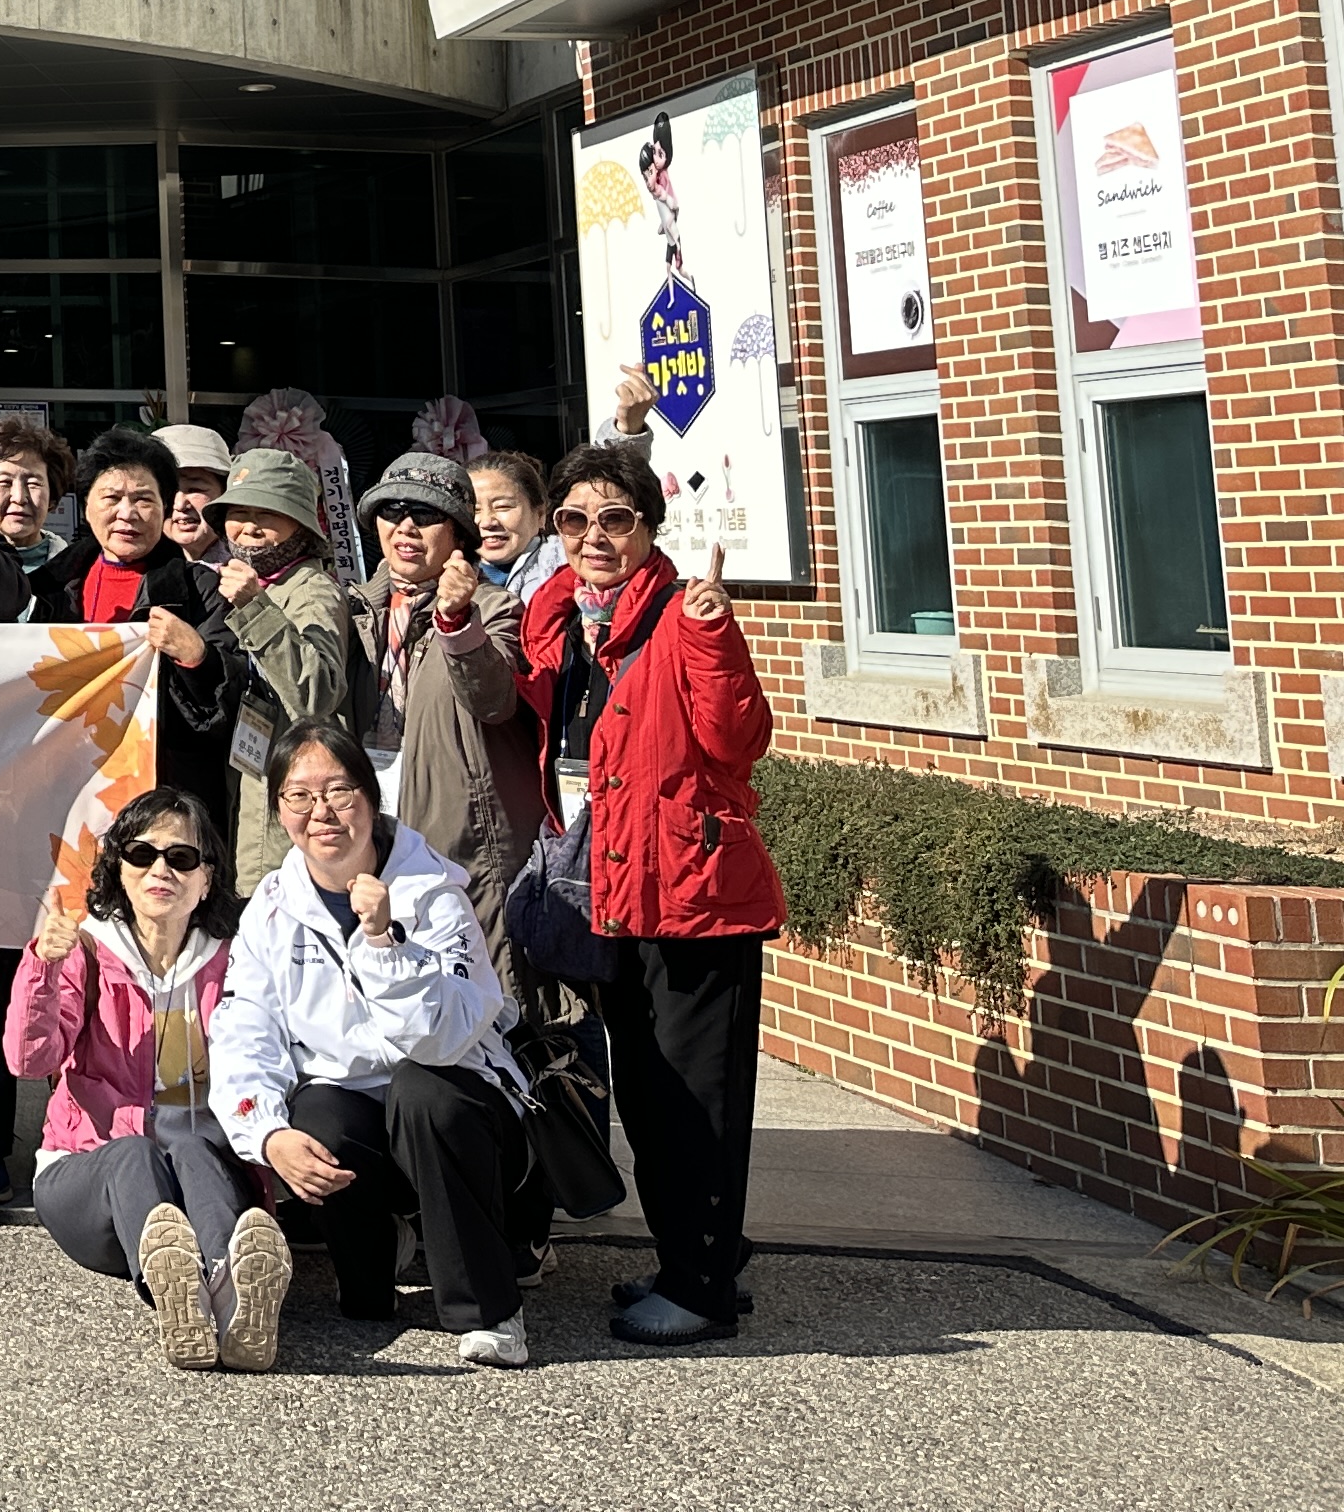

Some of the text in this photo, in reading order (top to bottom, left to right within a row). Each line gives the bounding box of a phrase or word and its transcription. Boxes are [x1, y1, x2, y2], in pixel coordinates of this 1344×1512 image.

[1097, 178, 1162, 207] Sandwich
[866, 200, 896, 220] Coffee
[1111, 238, 1130, 258] 치즈
[647, 347, 706, 397] 가겟방
[694, 508, 705, 532] 책
[716, 507, 747, 531] 기념품
